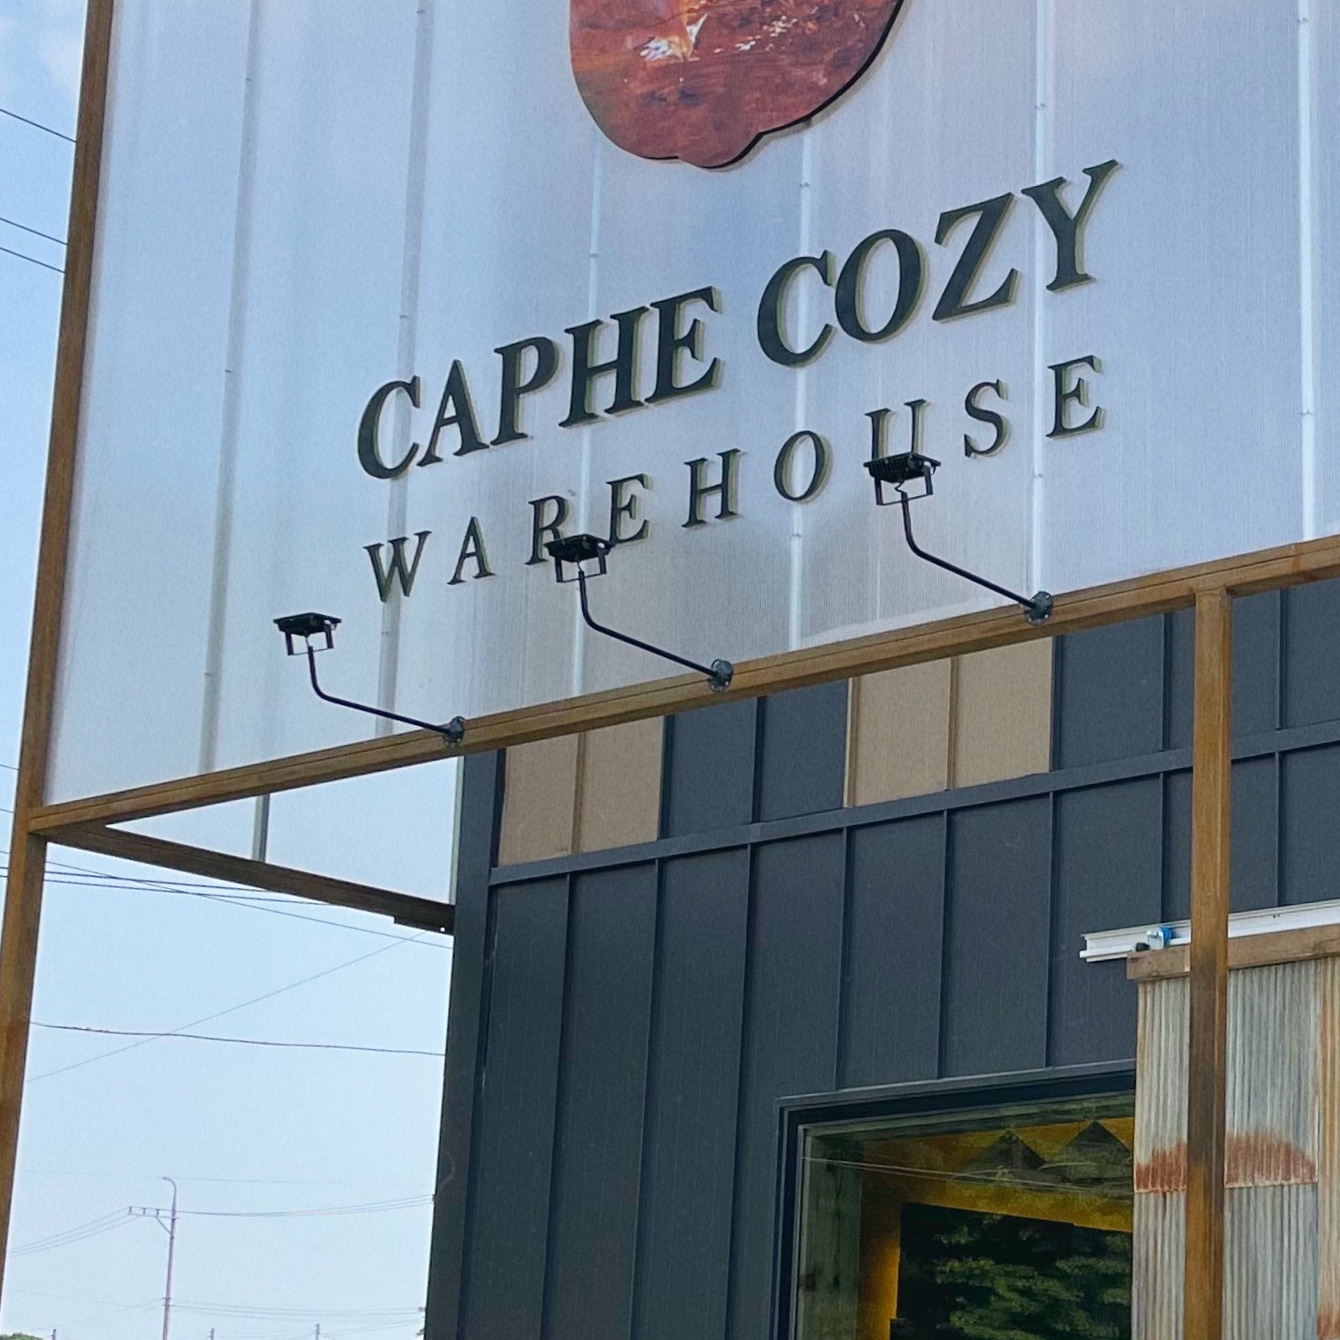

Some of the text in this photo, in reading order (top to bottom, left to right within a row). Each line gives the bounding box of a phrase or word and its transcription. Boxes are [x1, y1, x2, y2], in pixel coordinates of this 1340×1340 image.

[357, 158, 1120, 480] CAPHE COZY
[363, 354, 1105, 602] WAREHOUSE
